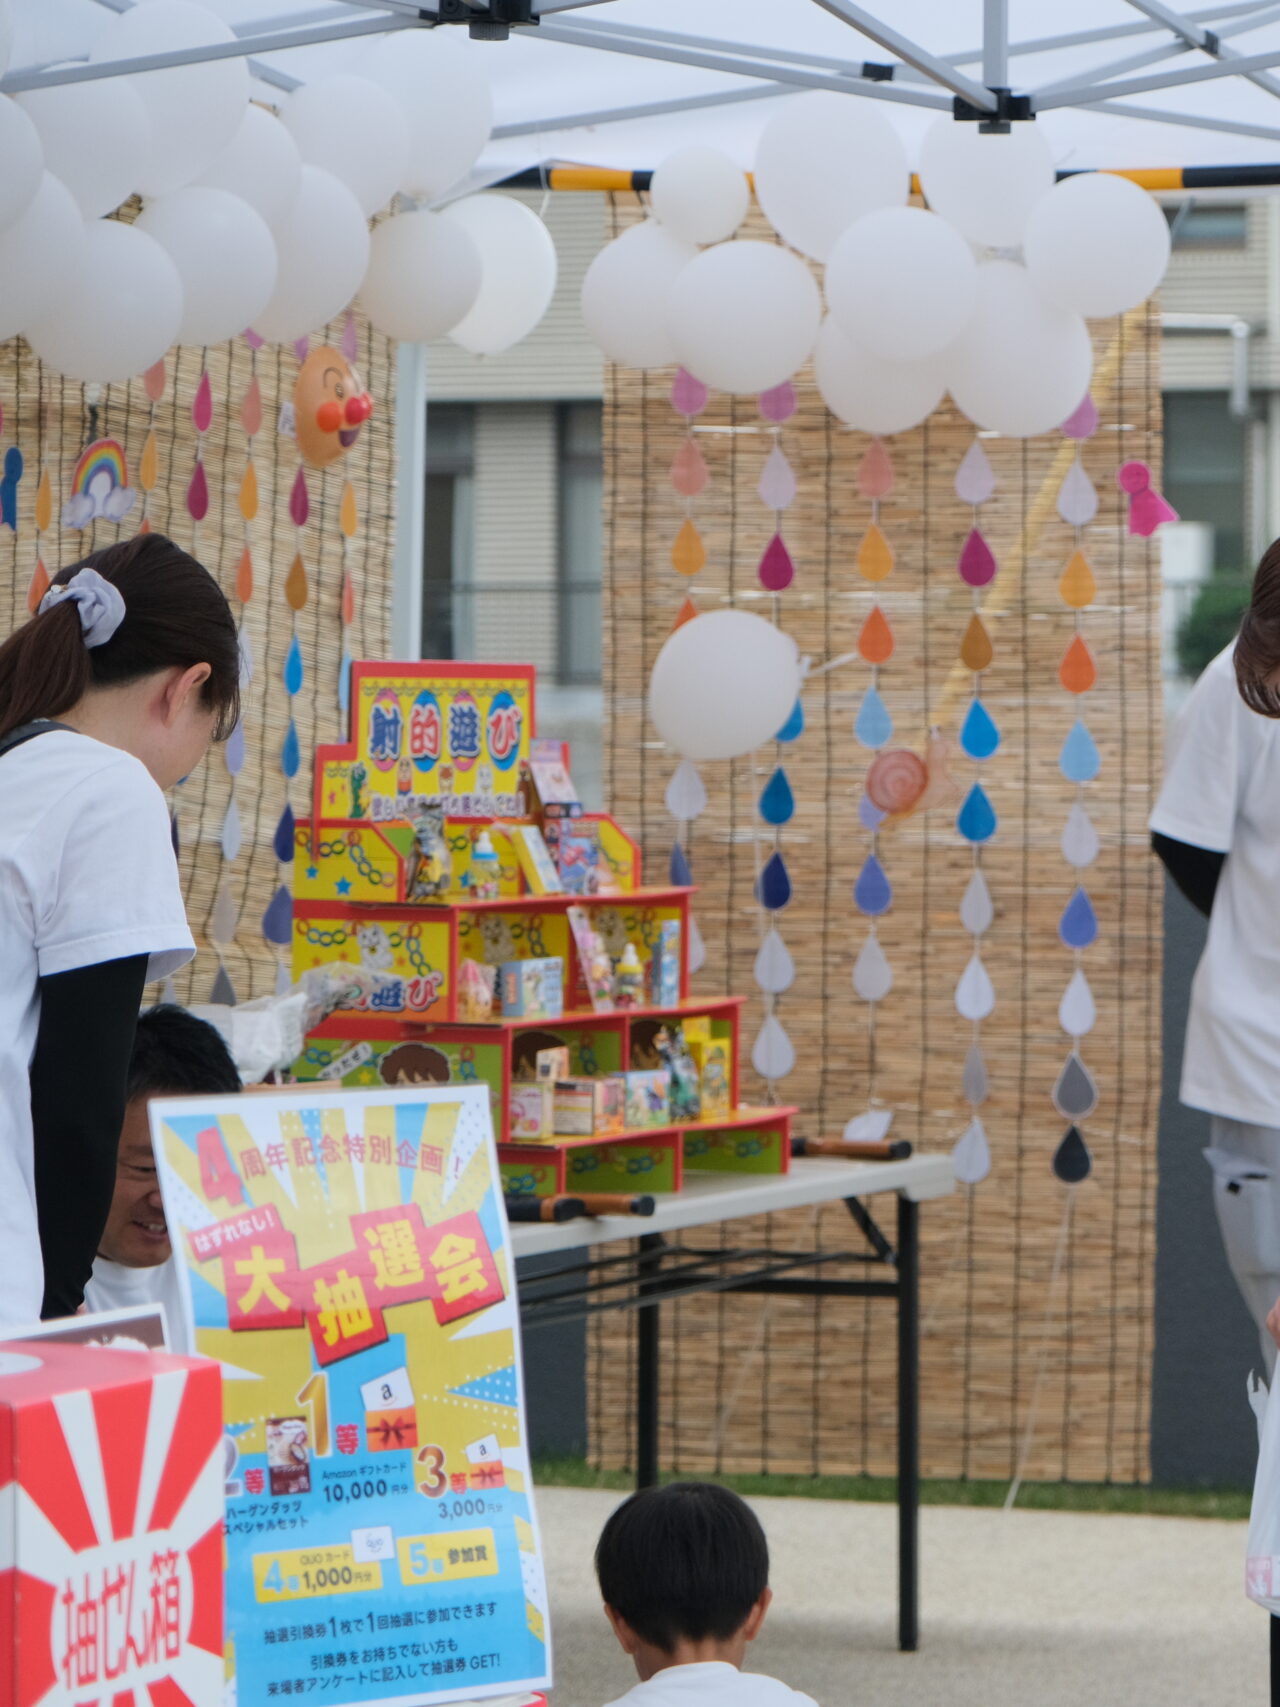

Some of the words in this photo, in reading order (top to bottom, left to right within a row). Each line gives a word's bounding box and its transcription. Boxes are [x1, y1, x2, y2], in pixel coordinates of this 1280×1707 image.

[369, 702, 523, 762] 射的遊び
[234, 1218, 489, 1347] 大抽選会
